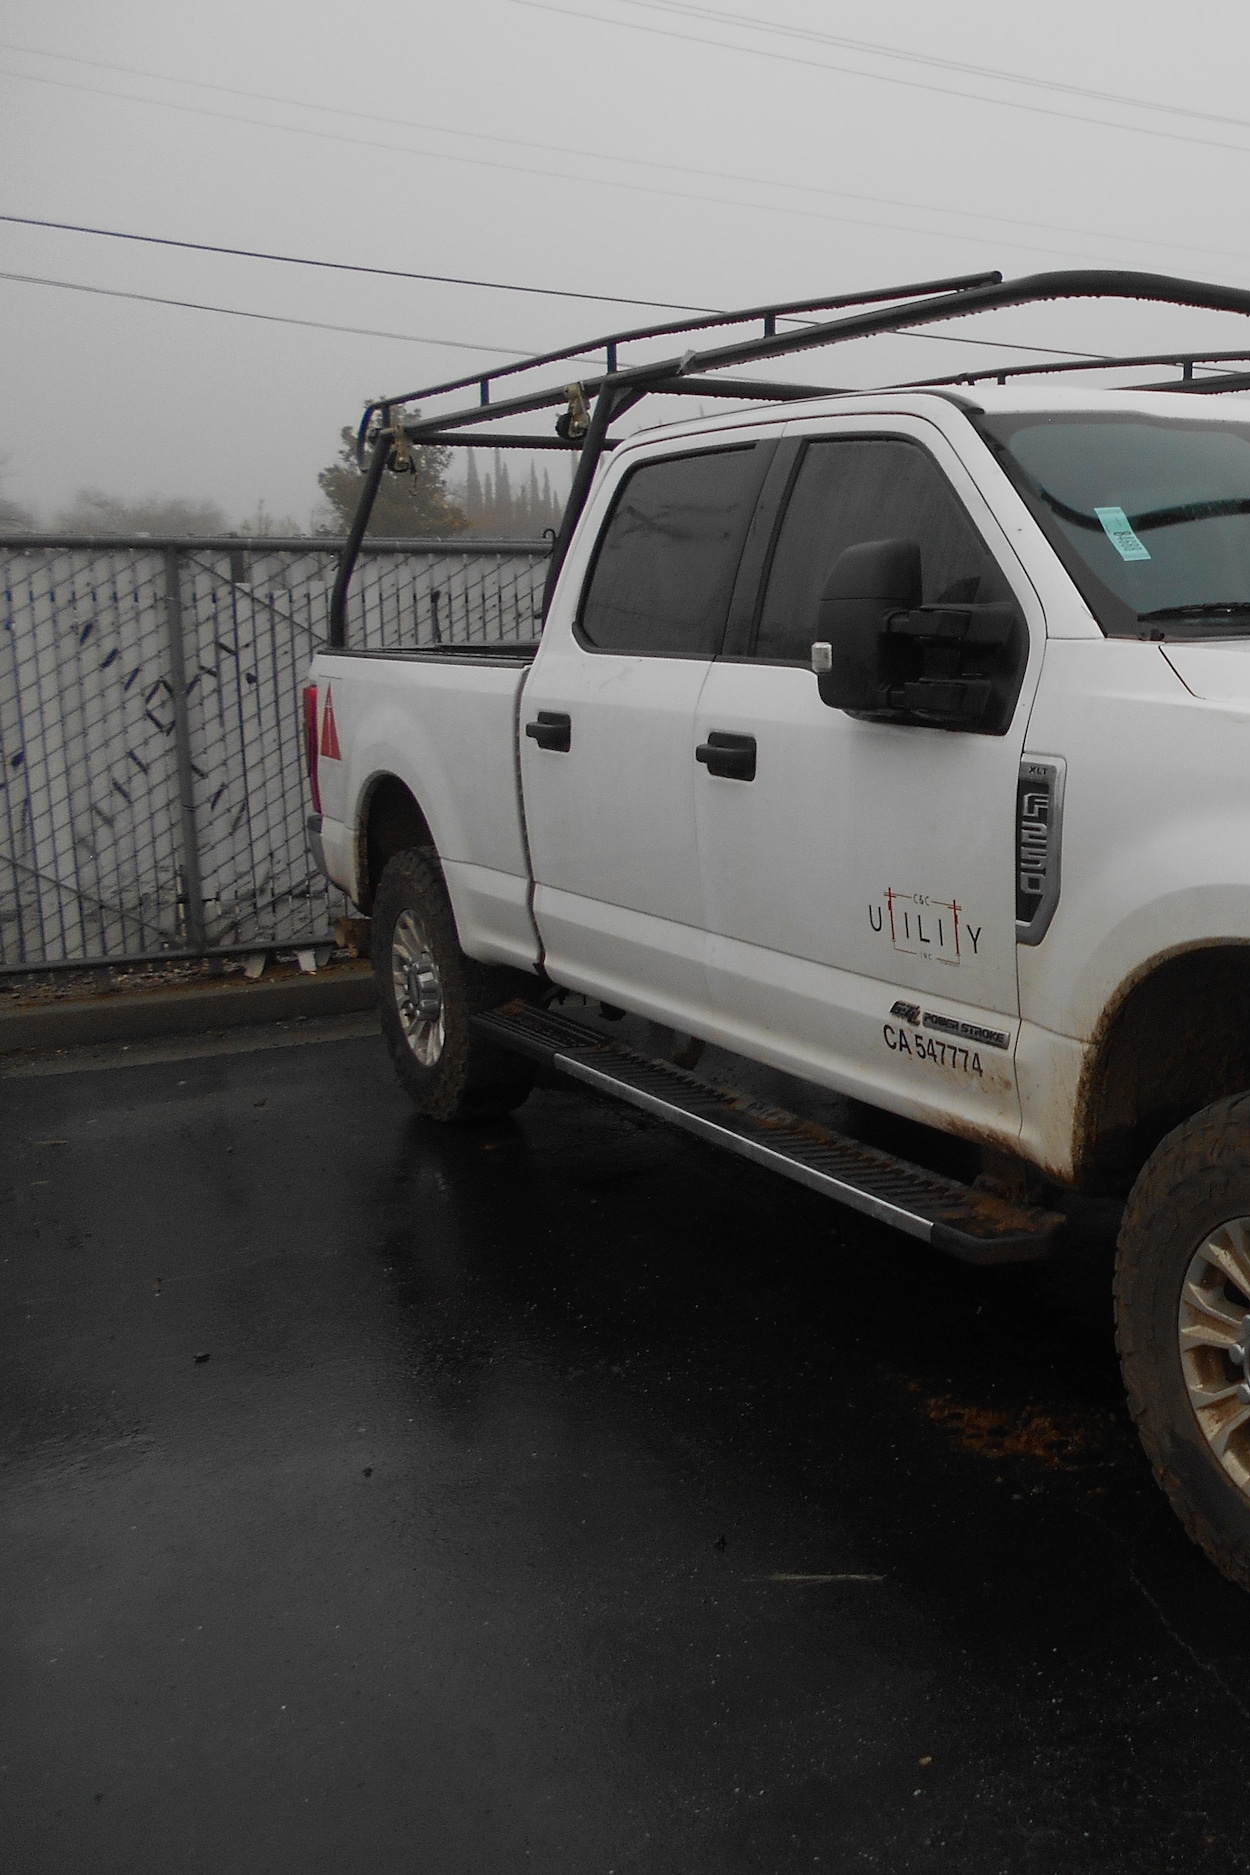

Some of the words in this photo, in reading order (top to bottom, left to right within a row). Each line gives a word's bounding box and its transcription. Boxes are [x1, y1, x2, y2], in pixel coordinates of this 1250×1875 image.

[1028, 765, 1048, 775] XLT
[1020, 792, 1049, 895] F250
[923, 1011, 959, 1031] POWER
[961, 1022, 1004, 1044] STROKE
[883, 1024, 912, 1055] CA
[914, 1033, 984, 1078] 547774
